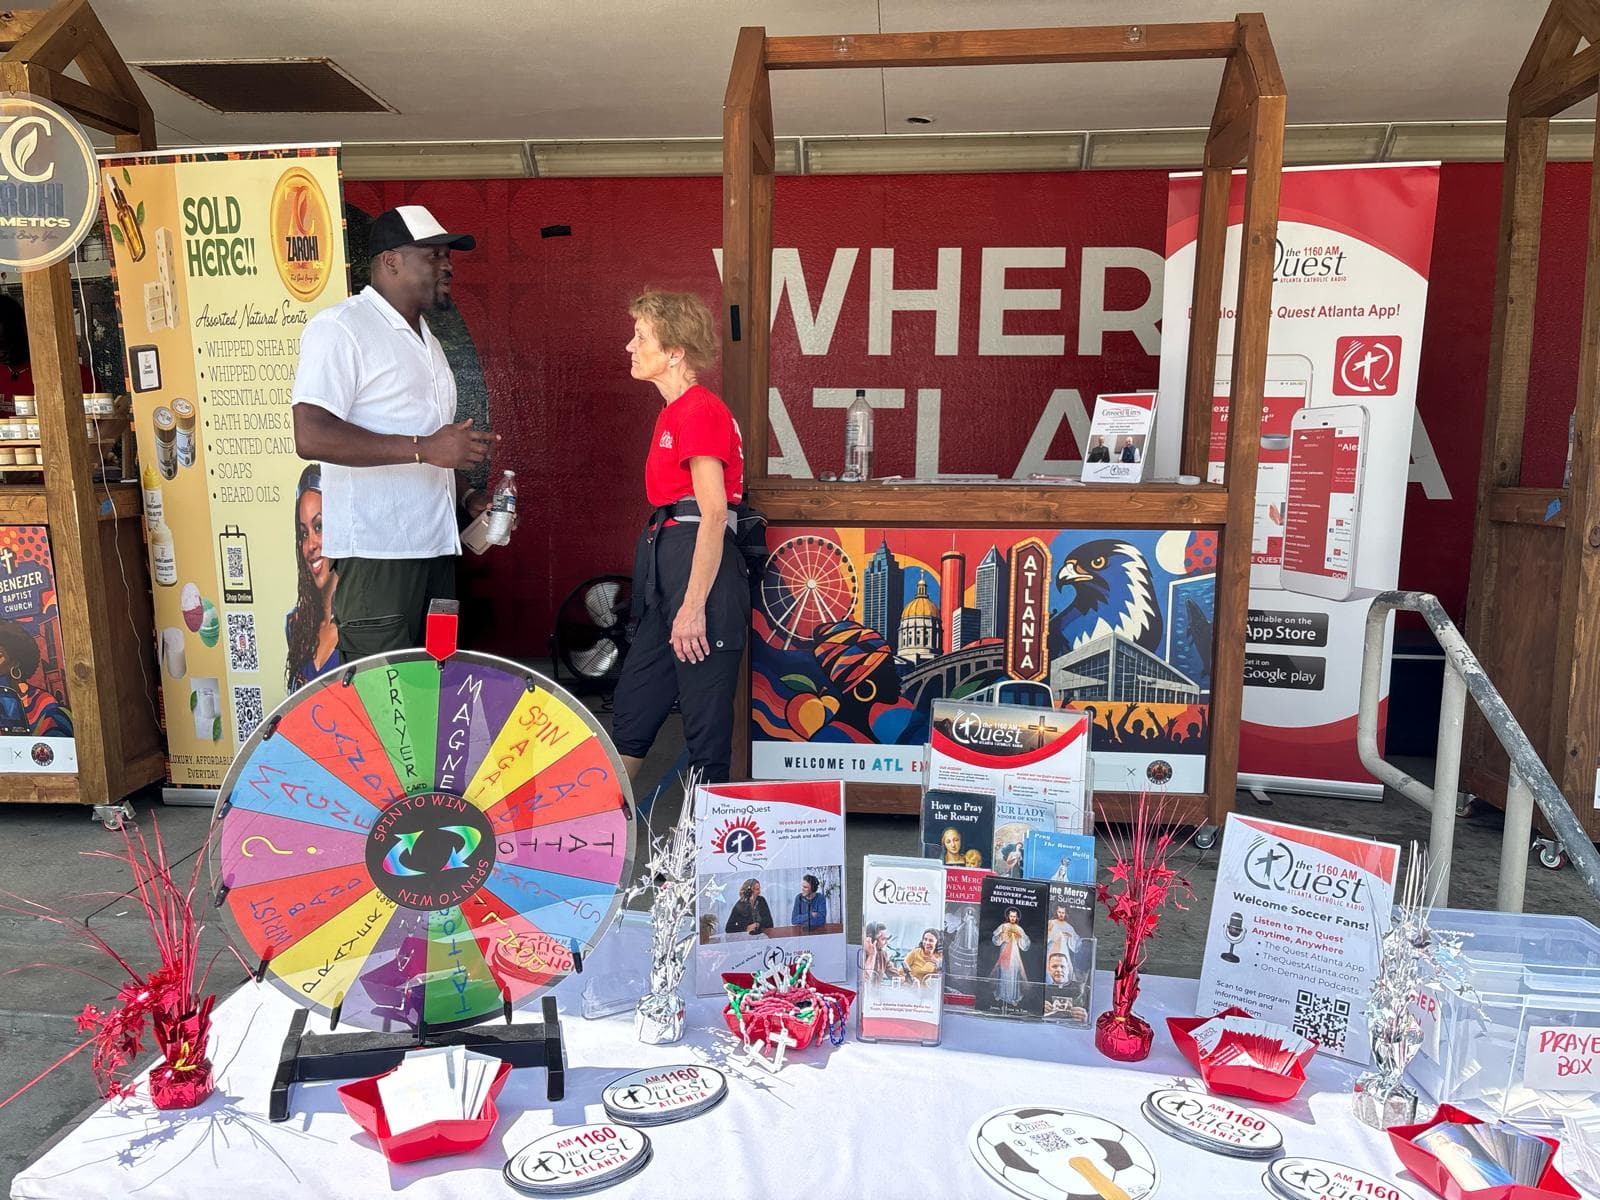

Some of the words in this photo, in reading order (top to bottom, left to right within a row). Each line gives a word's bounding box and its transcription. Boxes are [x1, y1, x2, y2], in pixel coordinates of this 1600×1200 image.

[183, 196, 242, 236] SOLD
[186, 237, 258, 277] HERE!!
[286, 235, 320, 262] ZAROHI
[1286, 247, 1301, 257] the
[1303, 246, 1323, 257] 1160
[1324, 245, 1340, 256] AM
[196, 303, 238, 328] Assorted
[238, 302, 279, 330] Natural
[281, 298, 309, 327] Scents
[1277, 305, 1316, 320] Quest
[1317, 304, 1365, 319] Atlanta
[1368, 303, 1401, 320] App!
[205, 340, 254, 358] WHIPPED
[256, 340, 285, 357] SHEA
[208, 365, 256, 382] WHIPPED
[259, 364, 296, 381] COCOA
[210, 389, 268, 407] ESSENTIAL
[269, 388, 293, 405] OILS
[213, 413, 242, 431] BATH
[243, 413, 282, 430] BOMBS
[283, 412, 292, 430] &
[215, 438, 263, 456] SCENTED
[219, 463, 253, 479] SOAPS
[220, 486, 254, 503] BEARD
[256, 486, 281, 502] OILS
[2, 590, 33, 604] BAPTIST
[4, 601, 33, 613] CHURCH
[1019, 554, 1038, 670] ATLANTA
[1284, 617, 1296, 625] on
[1297, 617, 1313, 626] the
[1276, 625, 1317, 641] Store
[1290, 670, 1317, 685] play
[387, 668, 418, 778] PRAYER
[519, 705, 570, 747] SPIN
[951, 710, 1024, 745] Quest
[993, 722, 1009, 731] 1160
[1008, 722, 1018, 731] AM
[784, 756, 845, 770] WELCOME
[851, 758, 866, 770] TO
[871, 758, 904, 772] ATL
[406, 782, 428, 793] CARD
[374, 808, 404, 842] SPIN
[402, 796, 426, 811] TO
[430, 794, 468, 813] WIN
[712, 804, 772, 816] MorningQuest
[931, 800, 951, 812] How
[952, 802, 963, 812] to
[963, 802, 983, 815] Pray
[934, 811, 948, 822] the
[949, 812, 979, 824] Rosary
[1017, 805, 1046, 818] LADY
[460, 859, 489, 893] SPIN
[1243, 841, 1367, 904] Quest
[1295, 860, 1313, 872] the
[1316, 863, 1339, 877] 1160
[1340, 868, 1358, 881] AM
[287, 877, 363, 918] BAND
[398, 888, 434, 907] WIN
[439, 890, 462, 905] TO
[872, 878, 930, 905] Quest
[968, 883, 982, 892] AND
[992, 890, 1022, 899] RECOVERY
[994, 884, 1027, 894] ADDICTION
[1063, 886, 1089, 900] Mercy
[990, 895, 1014, 905] DIVINE
[1015, 899, 1039, 908] MERCY
[1057, 894, 1086, 906] Suicide
[1287, 888, 1313, 899] ATLANTA
[1314, 895, 1344, 908] CATHOLIC
[1345, 902, 1365, 912] RADIO
[1232, 891, 1288, 913] Welcome
[1290, 905, 1333, 923] Soccer
[1335, 915, 1370, 932] Fans!
[249, 896, 294, 949] WRIST
[1253, 915, 1282, 929] Listen
[1283, 923, 1294, 932] to
[1295, 925, 1313, 936] The
[1315, 929, 1345, 944] Quest
[301, 907, 383, 994] PRAYER
[1251, 927, 1294, 944] Anytime,
[1295, 937, 1345, 956] Anywhere
[1262, 951, 1360, 984] TheQuestAtlanta.com
[1264, 941, 1281, 952] The
[1282, 944, 1309, 960] Quest
[1310, 953, 1344, 968] Atlanta
[1345, 961, 1365, 974] App
[1260, 963, 1317, 985] On-Demand
[1318, 977, 1361, 996] Podcasts
[1214, 989, 1258, 1007] information
[1258, 1002, 1274, 1011] and
[1216, 980, 1234, 990] Scan
[1244, 988, 1257, 997] get
[1257, 991, 1291, 1006] program
[1244, 1006, 1262, 1018] from
[644, 1075, 660, 1085] AM
[660, 1066, 700, 1085] 1160
[1557, 1055, 1593, 1077] BOX
[612, 1077, 714, 1111] Quest
[658, 1091, 707, 1109] ATLANTA
[1207, 1103, 1226, 1114] AM
[1224, 1110, 1266, 1132] 1160
[555, 1139, 575, 1150] AM
[573, 1126, 617, 1149] 1160
[1187, 1120, 1242, 1144] ATLANTA
[520, 1136, 634, 1183] Quest
[574, 1154, 629, 1178] ATLANTA
[1332, 1171, 1354, 1184] AM
[1353, 1179, 1400, 1200] 1160
